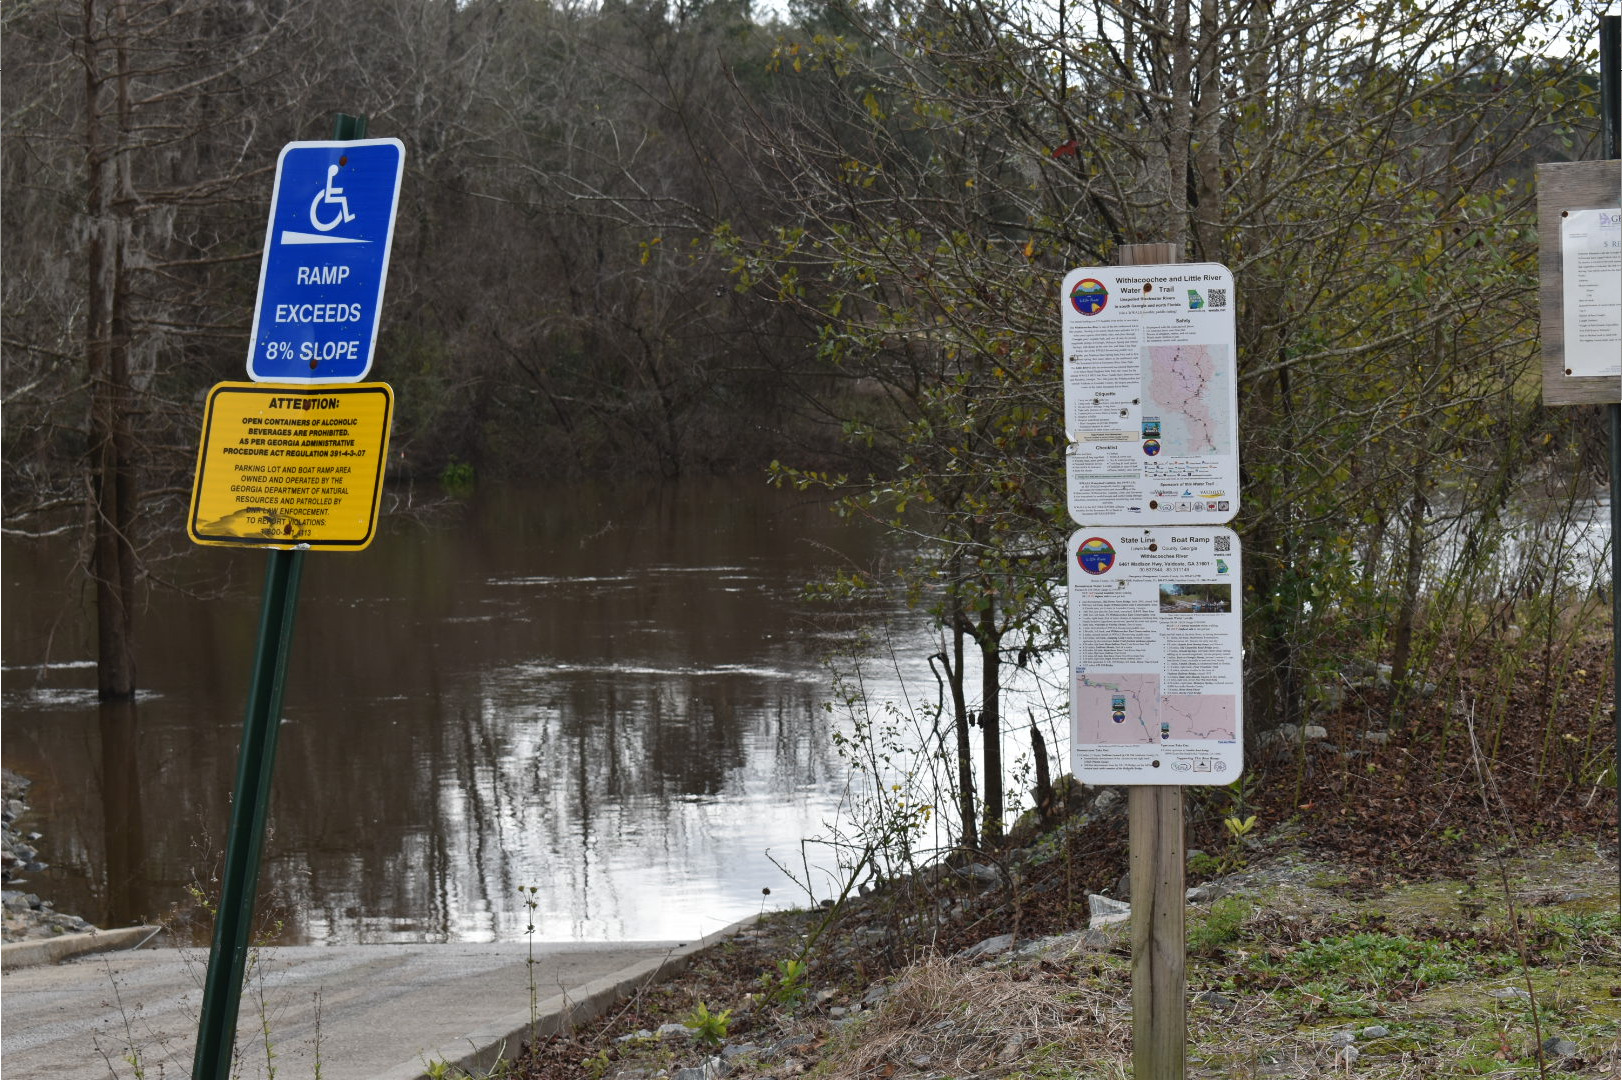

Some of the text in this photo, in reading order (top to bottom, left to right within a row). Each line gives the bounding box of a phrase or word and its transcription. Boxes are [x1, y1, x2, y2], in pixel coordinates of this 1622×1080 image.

[297, 266, 350, 285] RAMP
[275, 303, 361, 322] EXCEEDS
[266, 341, 359, 360] 8% SLOPE
[269, 398, 339, 410] ATTENTION:
[248, 428, 291, 436] BEVERAGES
[223, 448, 268, 456] PROCEDURE
[236, 496, 278, 504] RESOURCES
